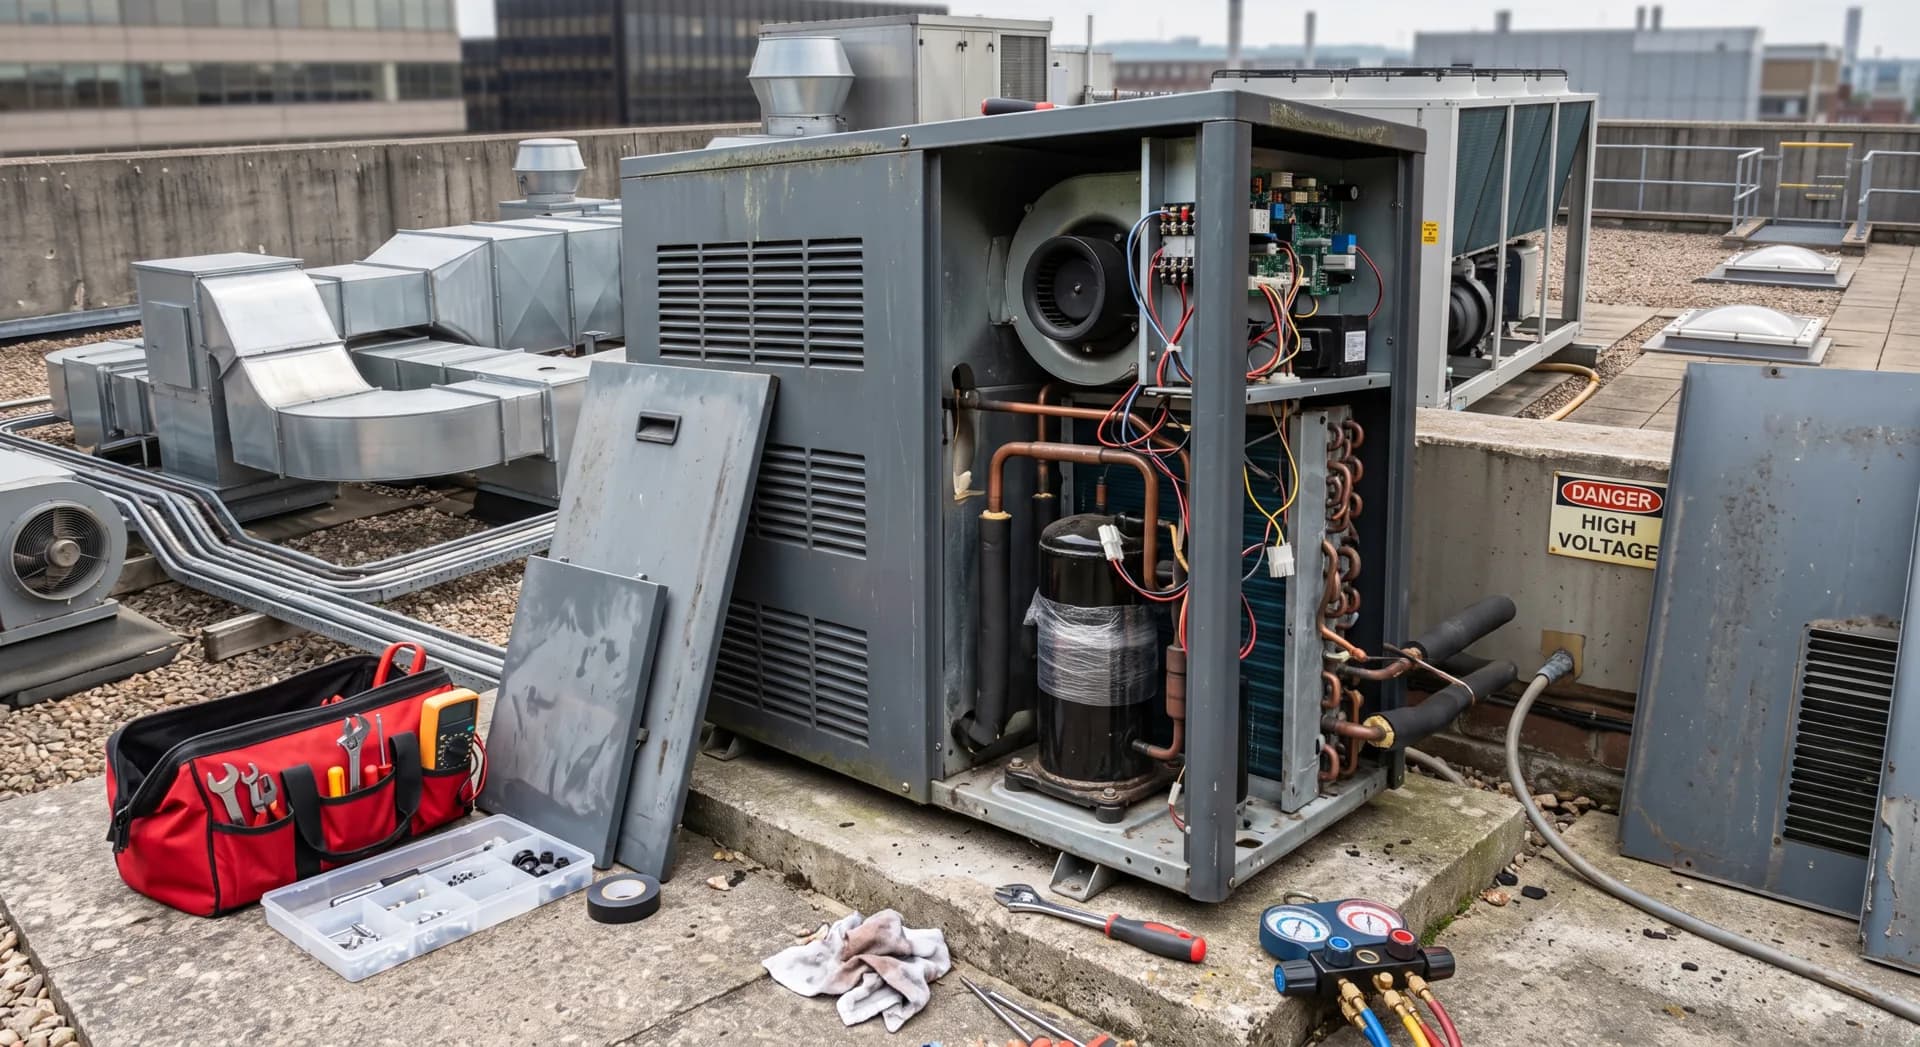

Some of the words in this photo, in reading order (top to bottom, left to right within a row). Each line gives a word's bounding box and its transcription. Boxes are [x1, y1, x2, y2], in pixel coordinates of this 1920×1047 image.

[1572, 485, 1652, 509] DANGER
[1582, 514, 1636, 536] HIGH
[1559, 532, 1658, 561] VOLTAGE
